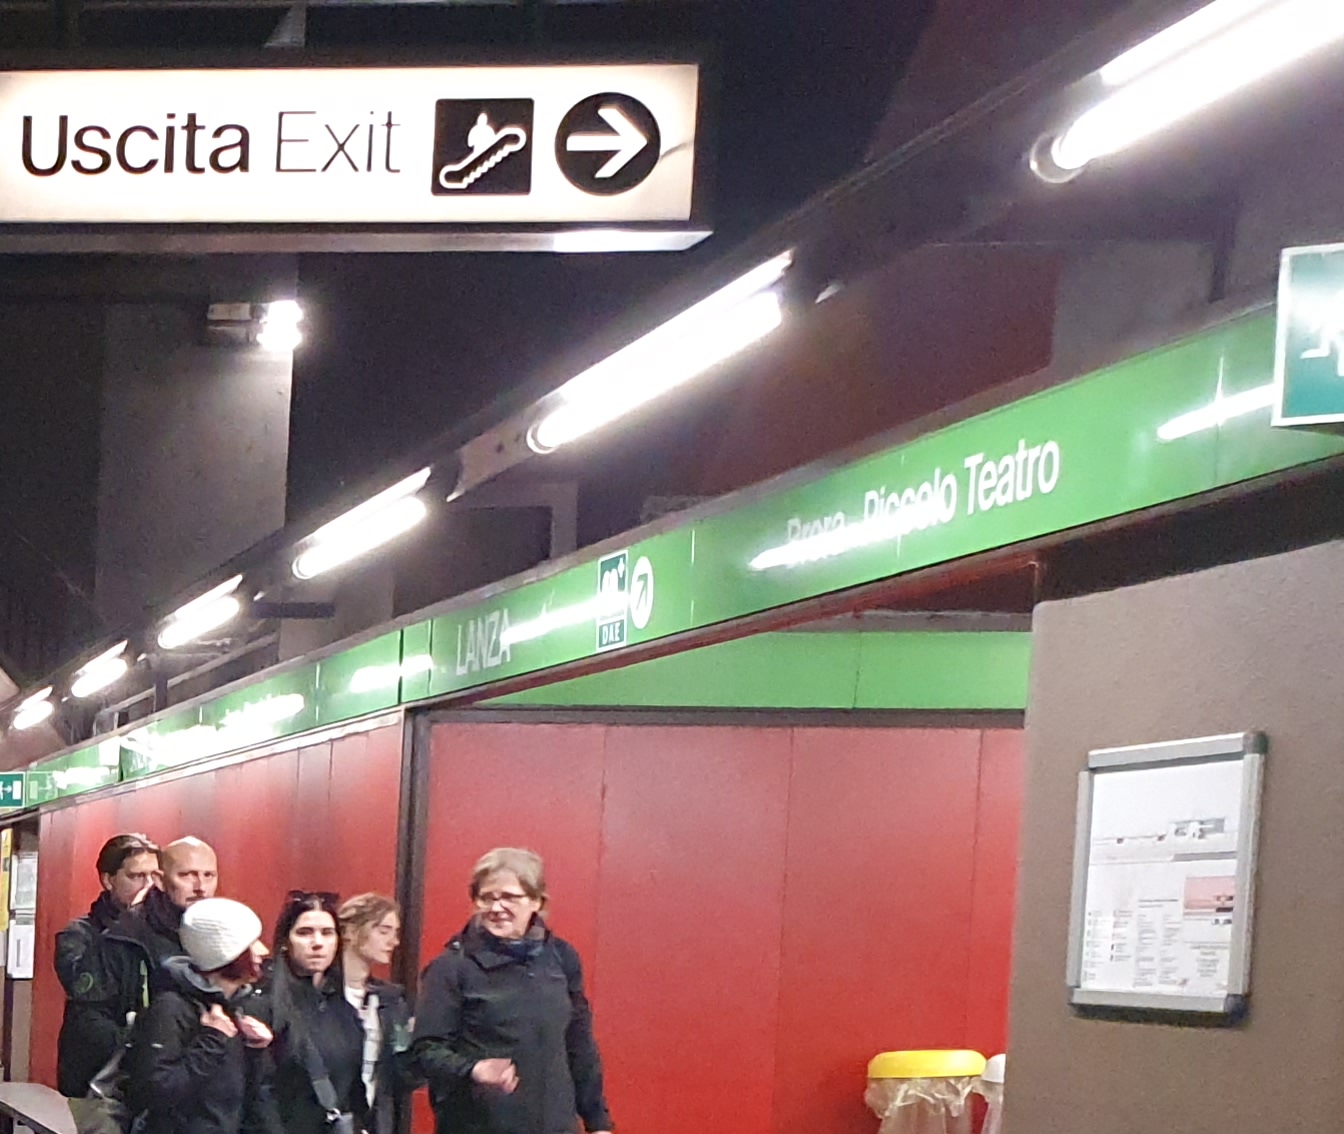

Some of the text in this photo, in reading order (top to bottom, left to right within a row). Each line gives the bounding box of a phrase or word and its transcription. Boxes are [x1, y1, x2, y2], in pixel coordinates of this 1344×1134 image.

[21, 110, 401, 177] Uscita Exit
[964, 438, 1060, 515] Teatro
[456, 608, 511, 676] LANZA
[602, 622, 621, 645] DAE
